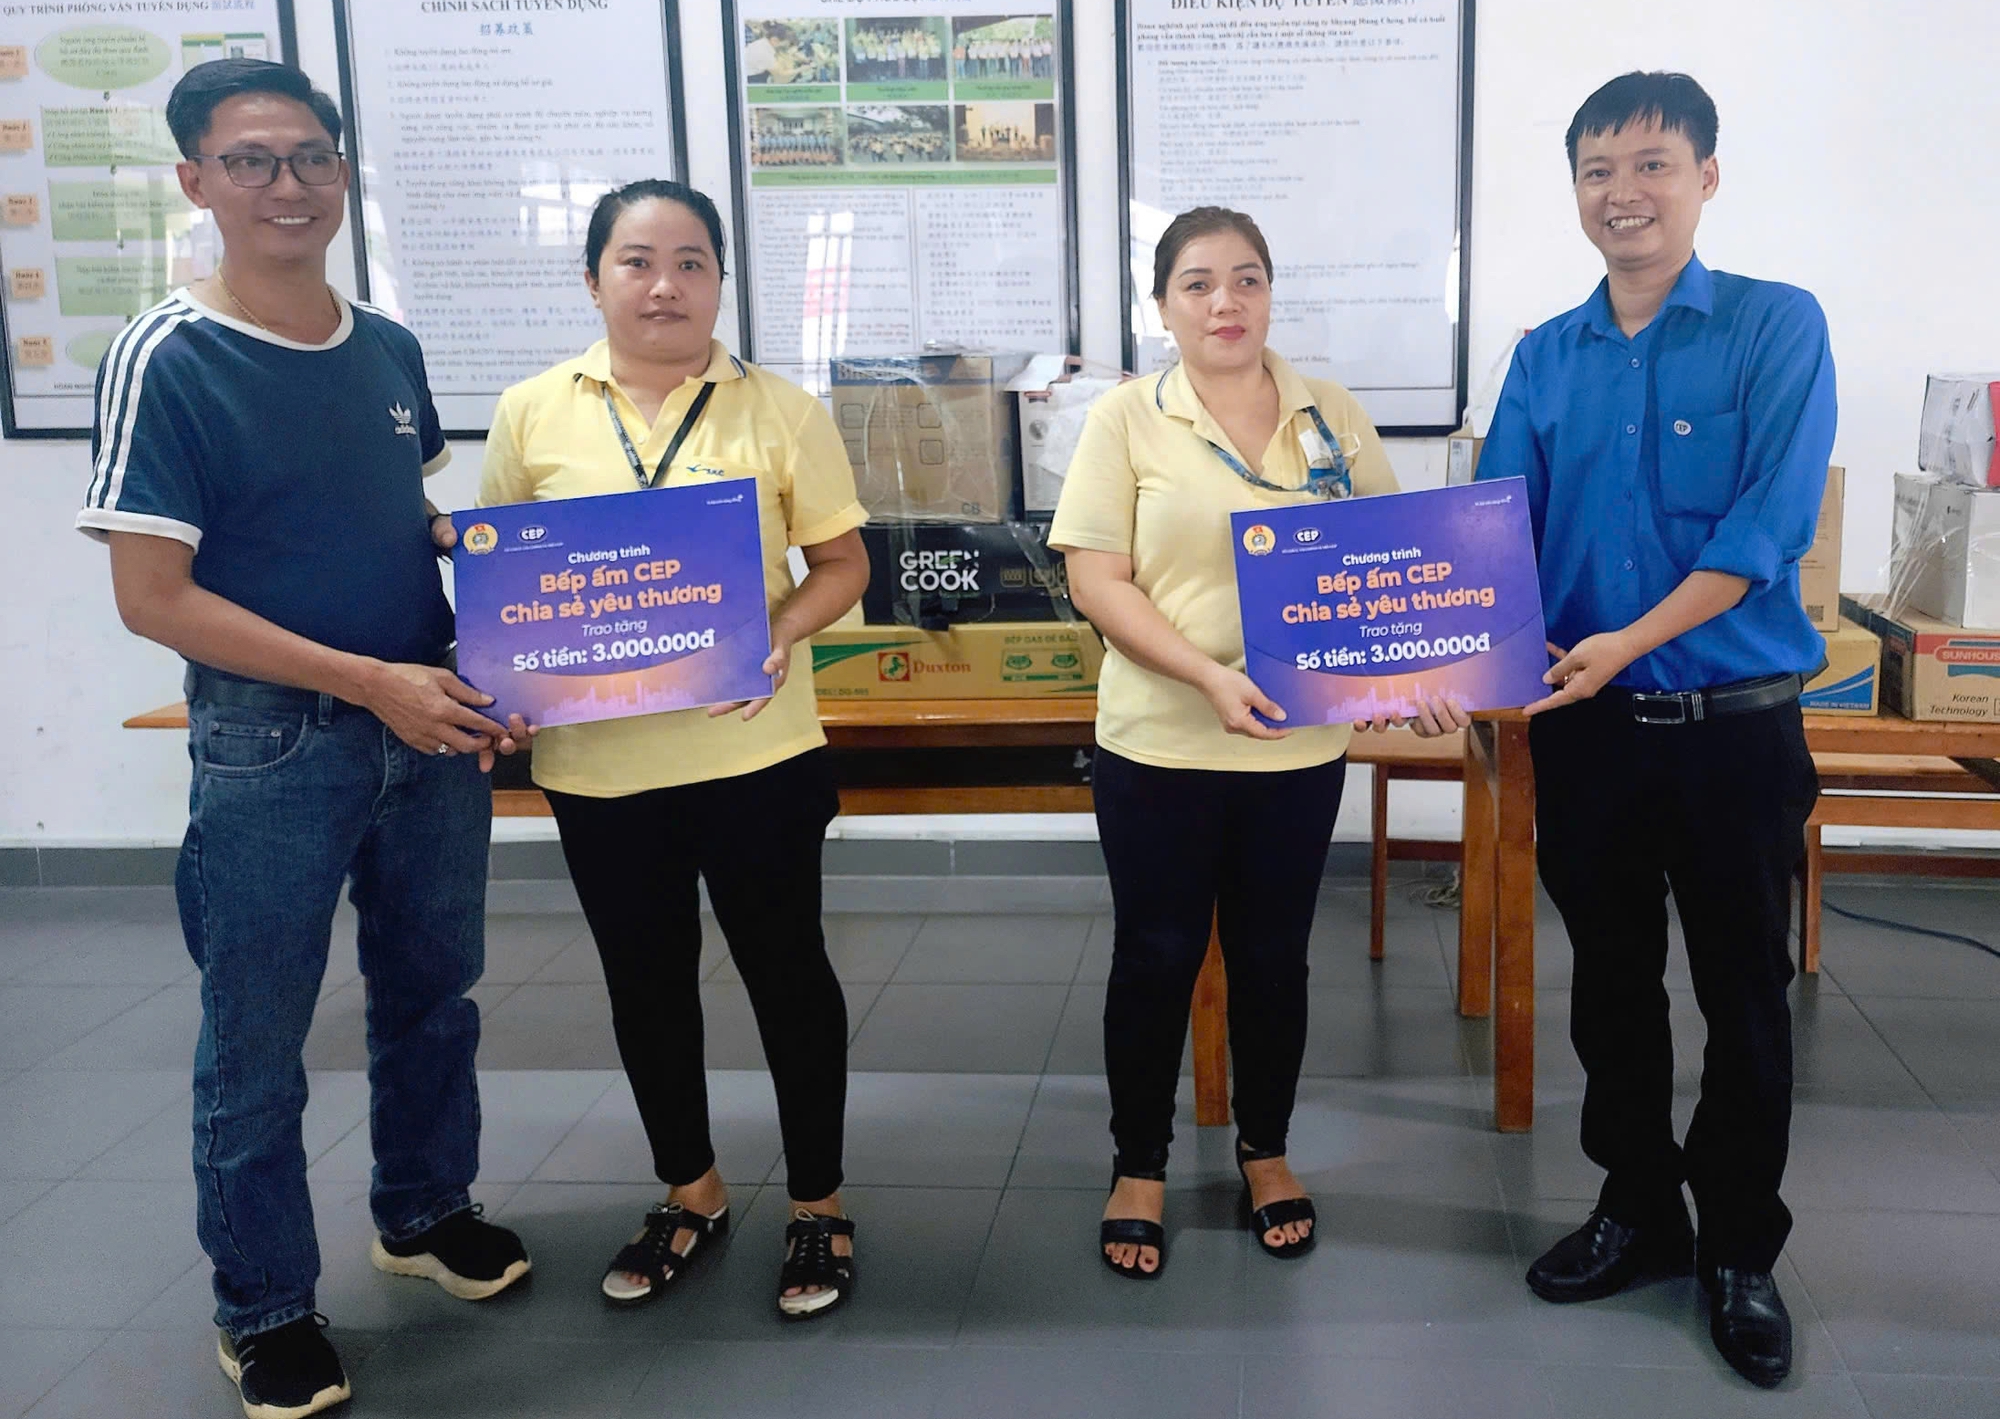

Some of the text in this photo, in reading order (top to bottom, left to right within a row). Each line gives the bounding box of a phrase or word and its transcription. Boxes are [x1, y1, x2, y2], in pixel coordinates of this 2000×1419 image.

[521, 526, 546, 541] CEP
[1296, 530, 1319, 542] CEP
[567, 543, 651, 565] Chương trình
[1342, 546, 1422, 566] Chương trình
[539, 559, 681, 594] Bếp ấm CEP
[900, 569, 980, 591] COOK
[1316, 561, 1452, 595] Bếp ấm CEP
[500, 583, 722, 625] Chia sẻ yêu thương
[1282, 586, 1496, 625] Chia sẻ yêu thương
[581, 620, 648, 638] Trao tặng
[1359, 621, 1423, 639] Trao tặng
[512, 627, 716, 672] Số tiền: 3.000.000đ
[1295, 632, 1491, 671] Số tiền: 3.000.000đ
[912, 660, 972, 675] Duxton
[1952, 693, 1989, 704] Korean
[1929, 704, 1989, 718] Technology
